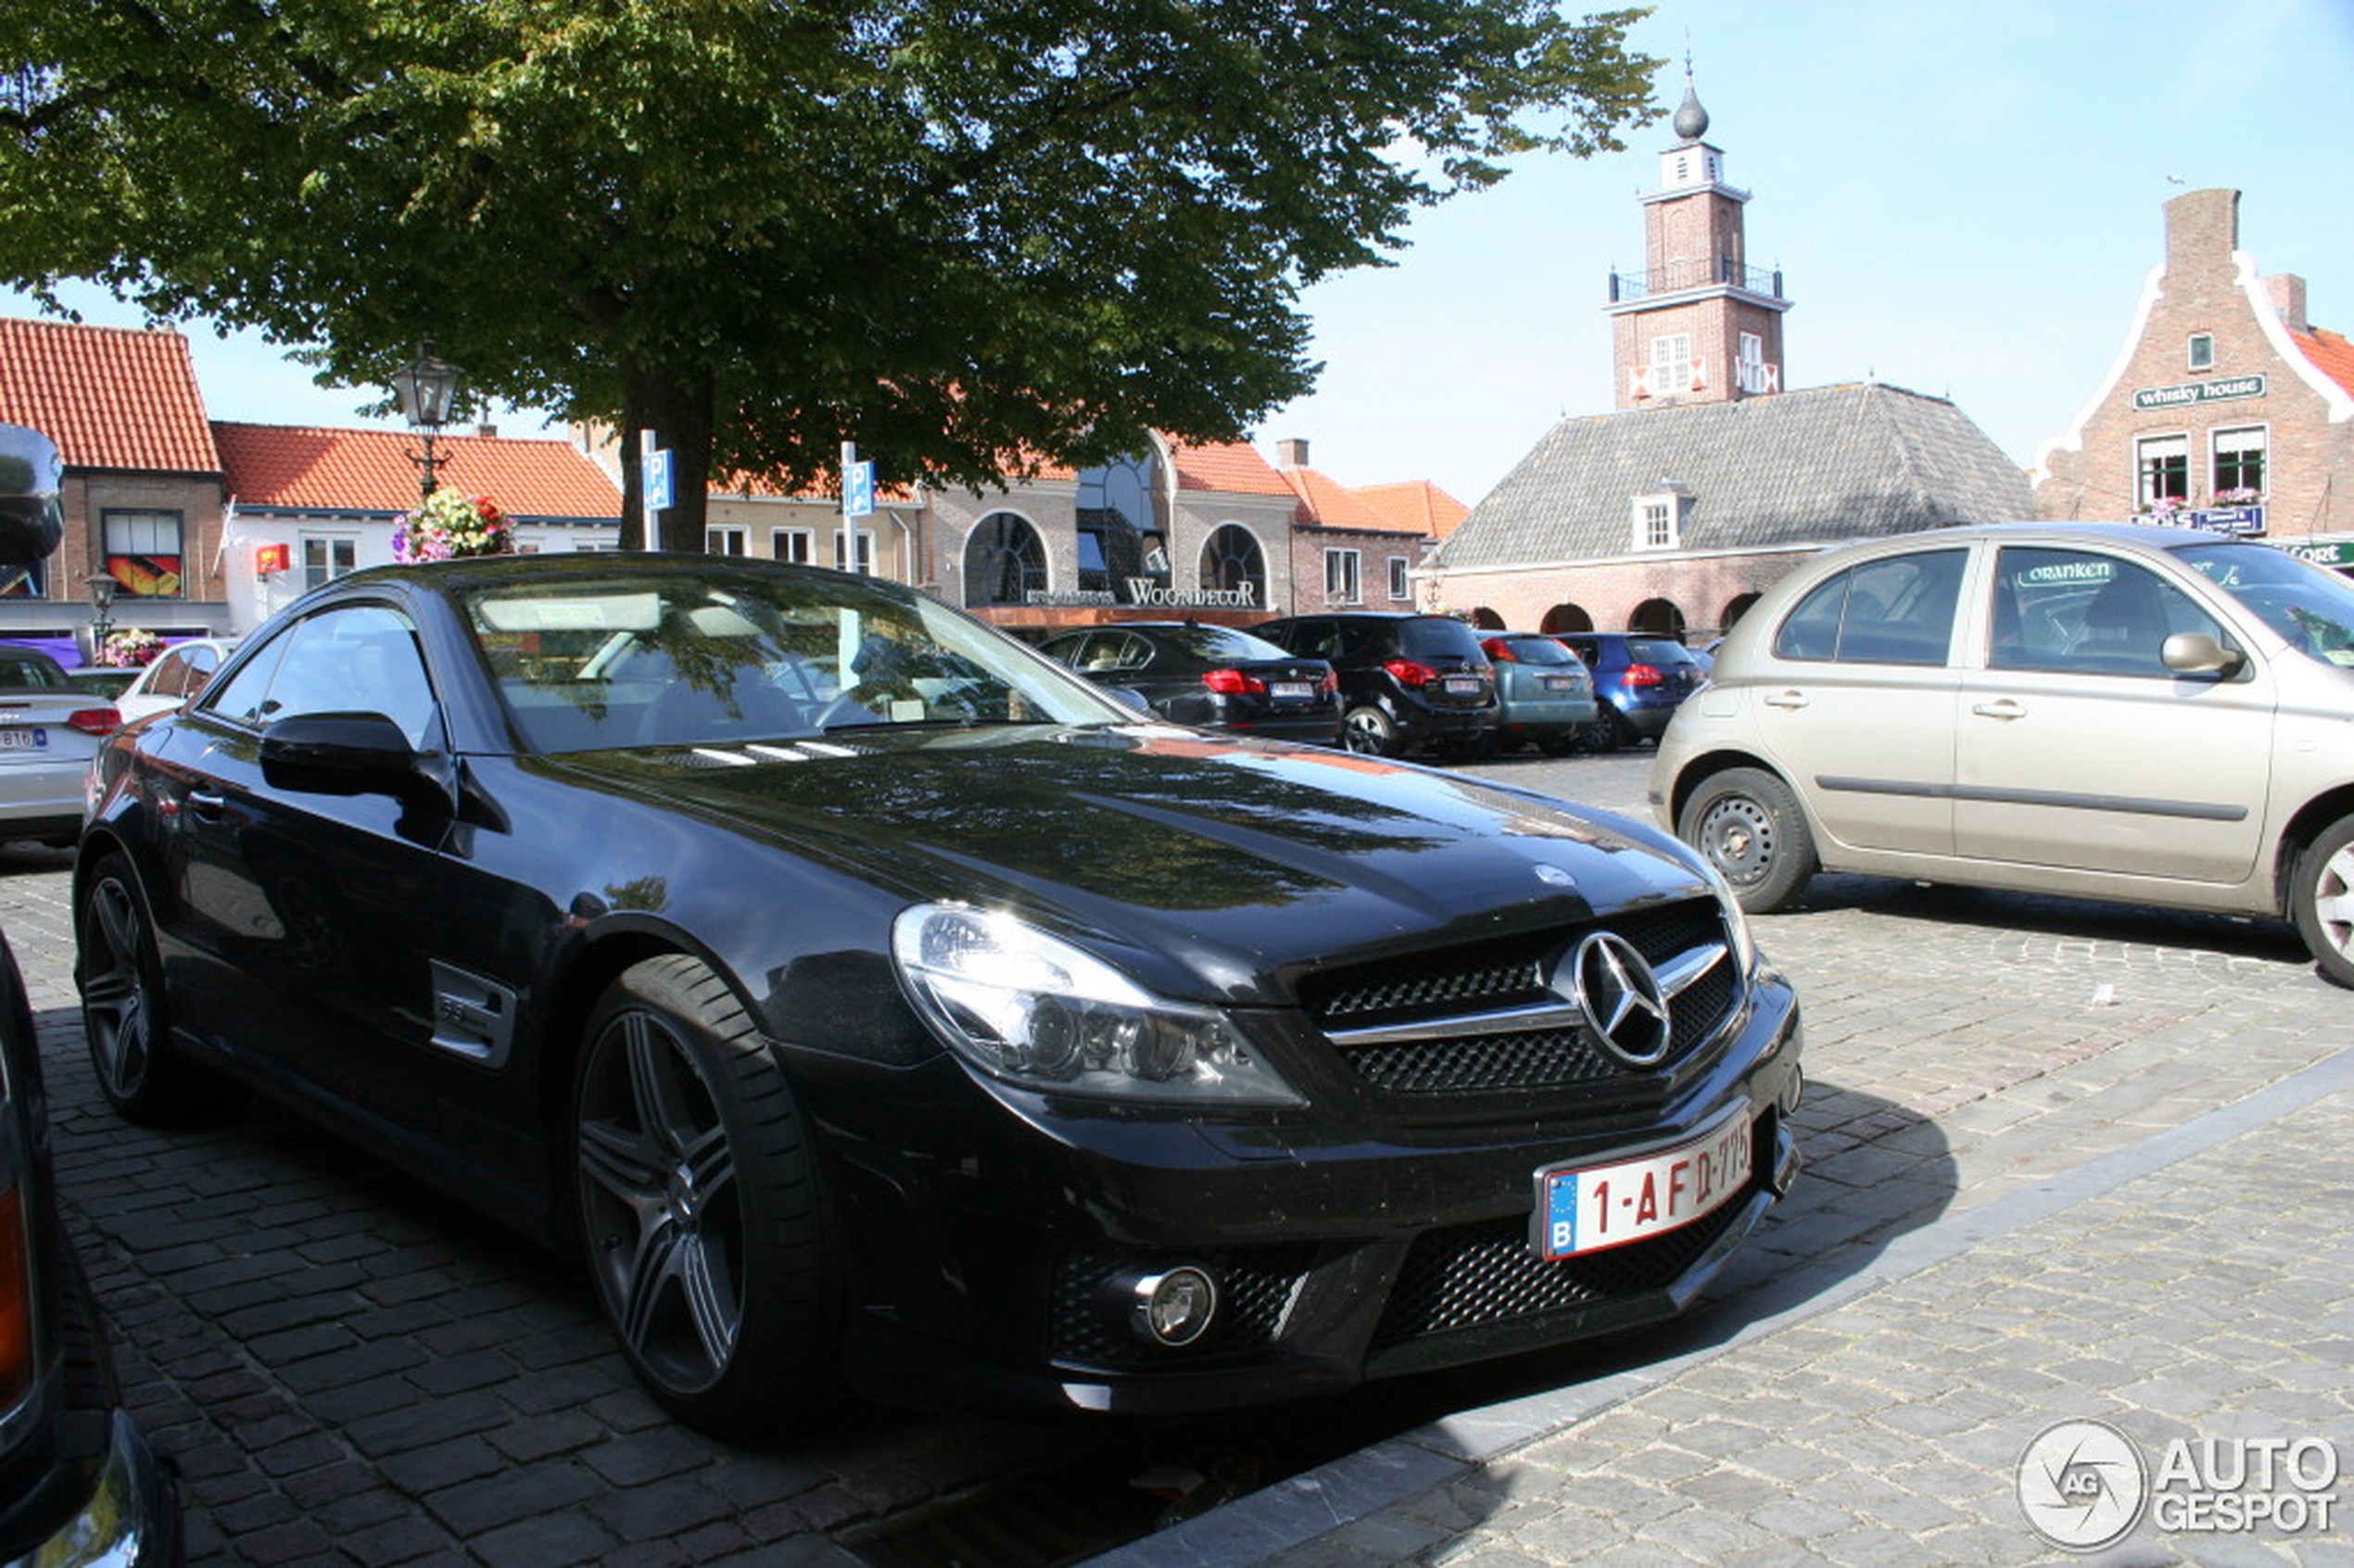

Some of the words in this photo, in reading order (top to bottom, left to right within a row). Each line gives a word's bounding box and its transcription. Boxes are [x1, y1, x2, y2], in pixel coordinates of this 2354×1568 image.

[2204, 379, 2259, 398] house
[852, 468, 865, 492] P
[1127, 576, 1255, 607] WOONDECOR
[1593, 1121, 1750, 1233] 1-AFD-775
[1553, 1221, 1571, 1246] B
